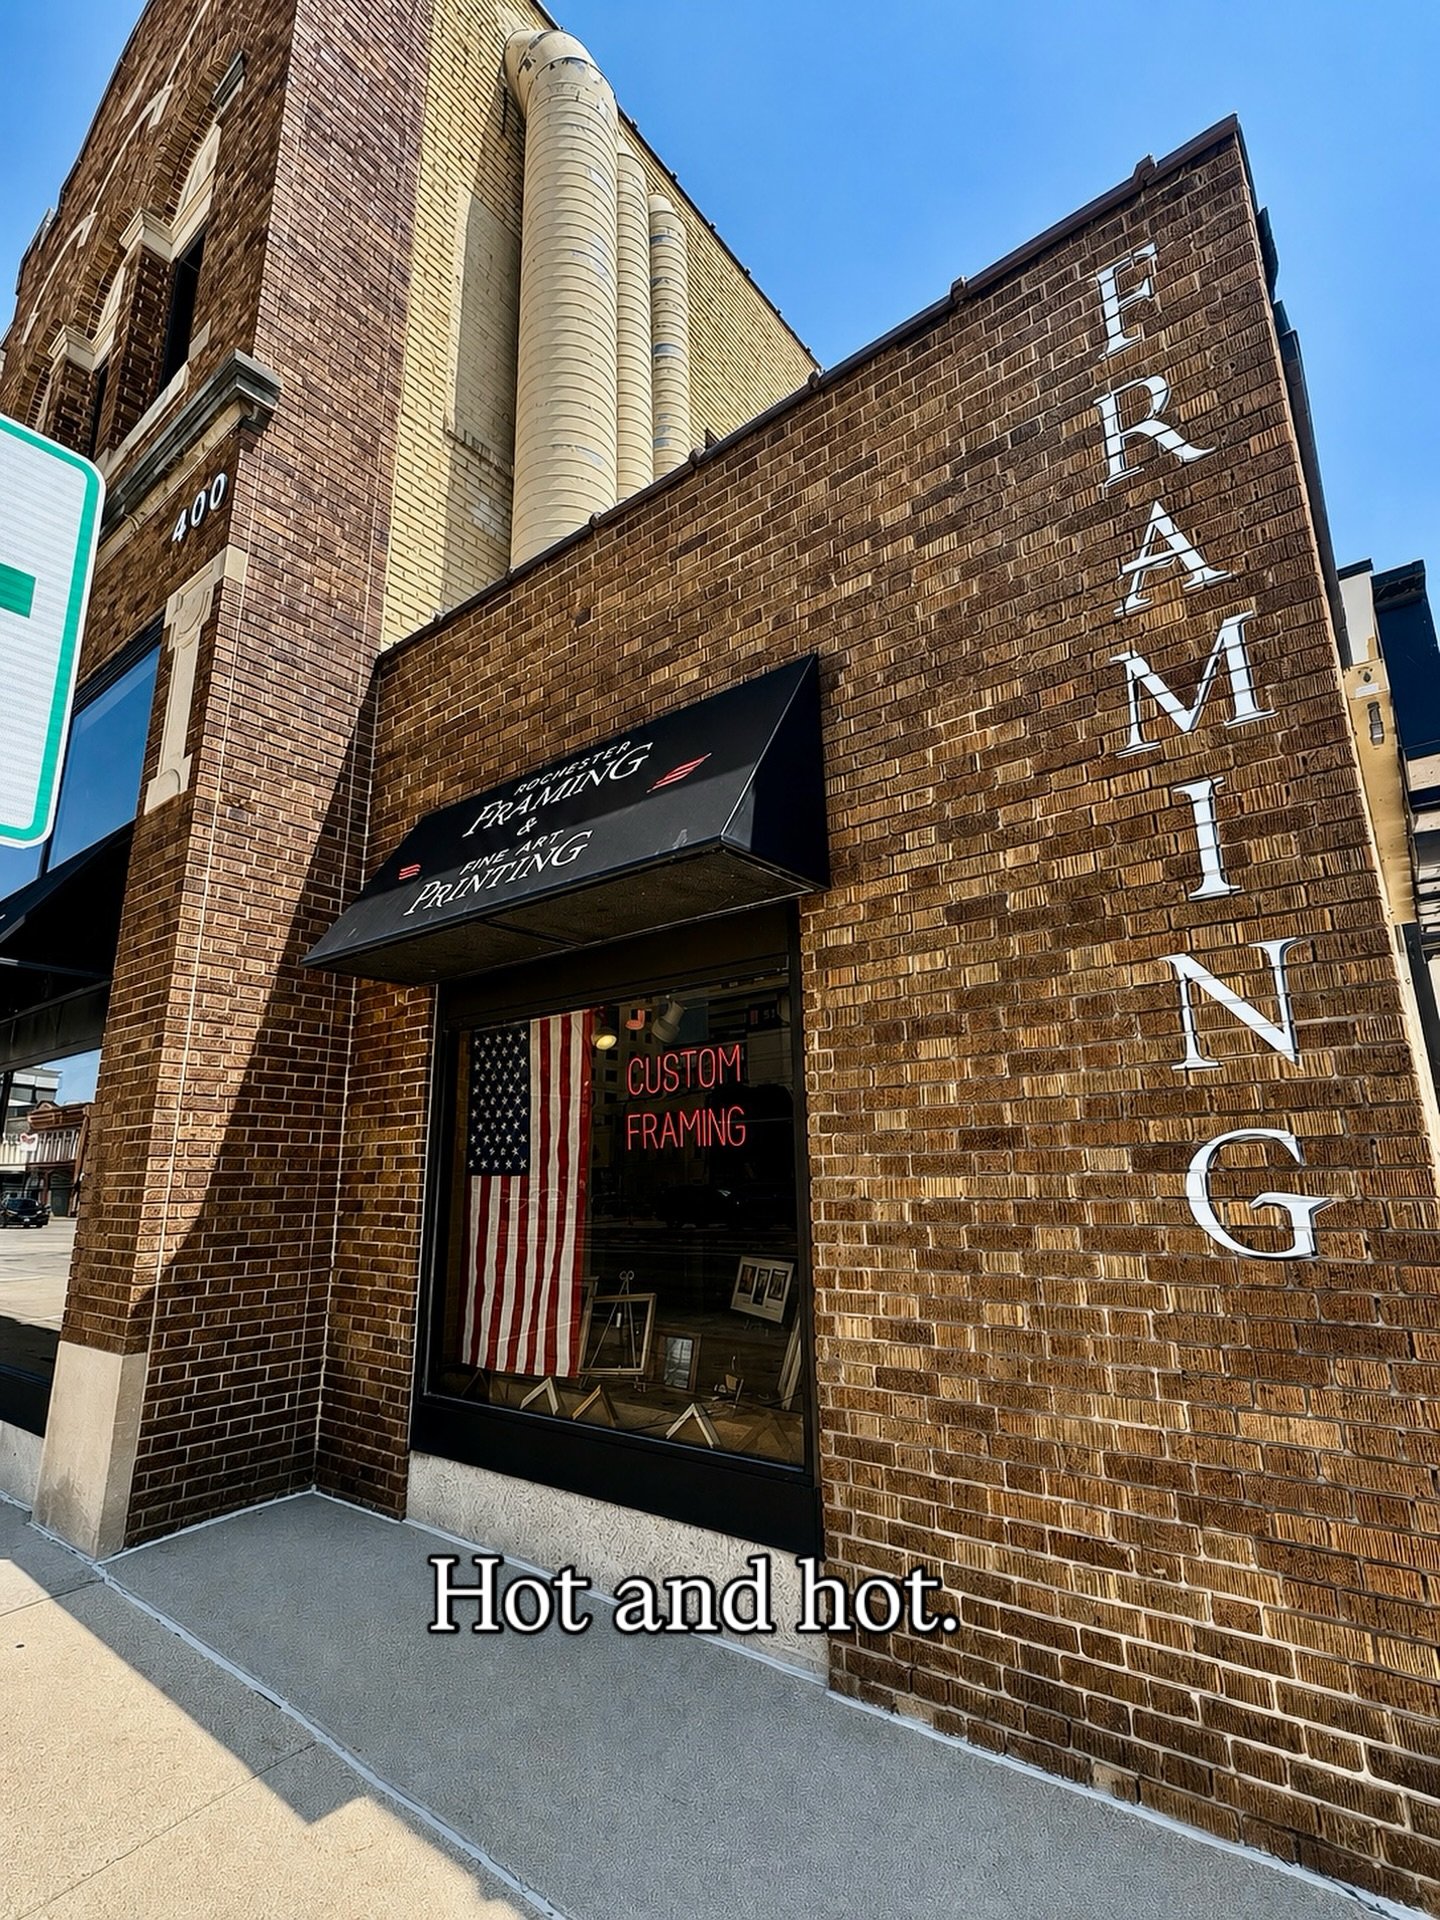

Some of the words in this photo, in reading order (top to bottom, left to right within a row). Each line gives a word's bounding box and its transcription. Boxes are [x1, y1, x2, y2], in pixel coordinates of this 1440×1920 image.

[171, 473, 228, 542] 400
[515, 740, 631, 796] ROCHESTER
[1092, 241, 1335, 1260] FRAMING
[462, 743, 654, 838] FRAMING
[460, 849, 509, 876] FINE
[515, 829, 566, 855] ART
[517, 816, 538, 836] &
[403, 830, 593, 916] PRINTING
[627, 1044, 742, 1096] CUSTOM
[627, 1105, 746, 1151] FRAMING
